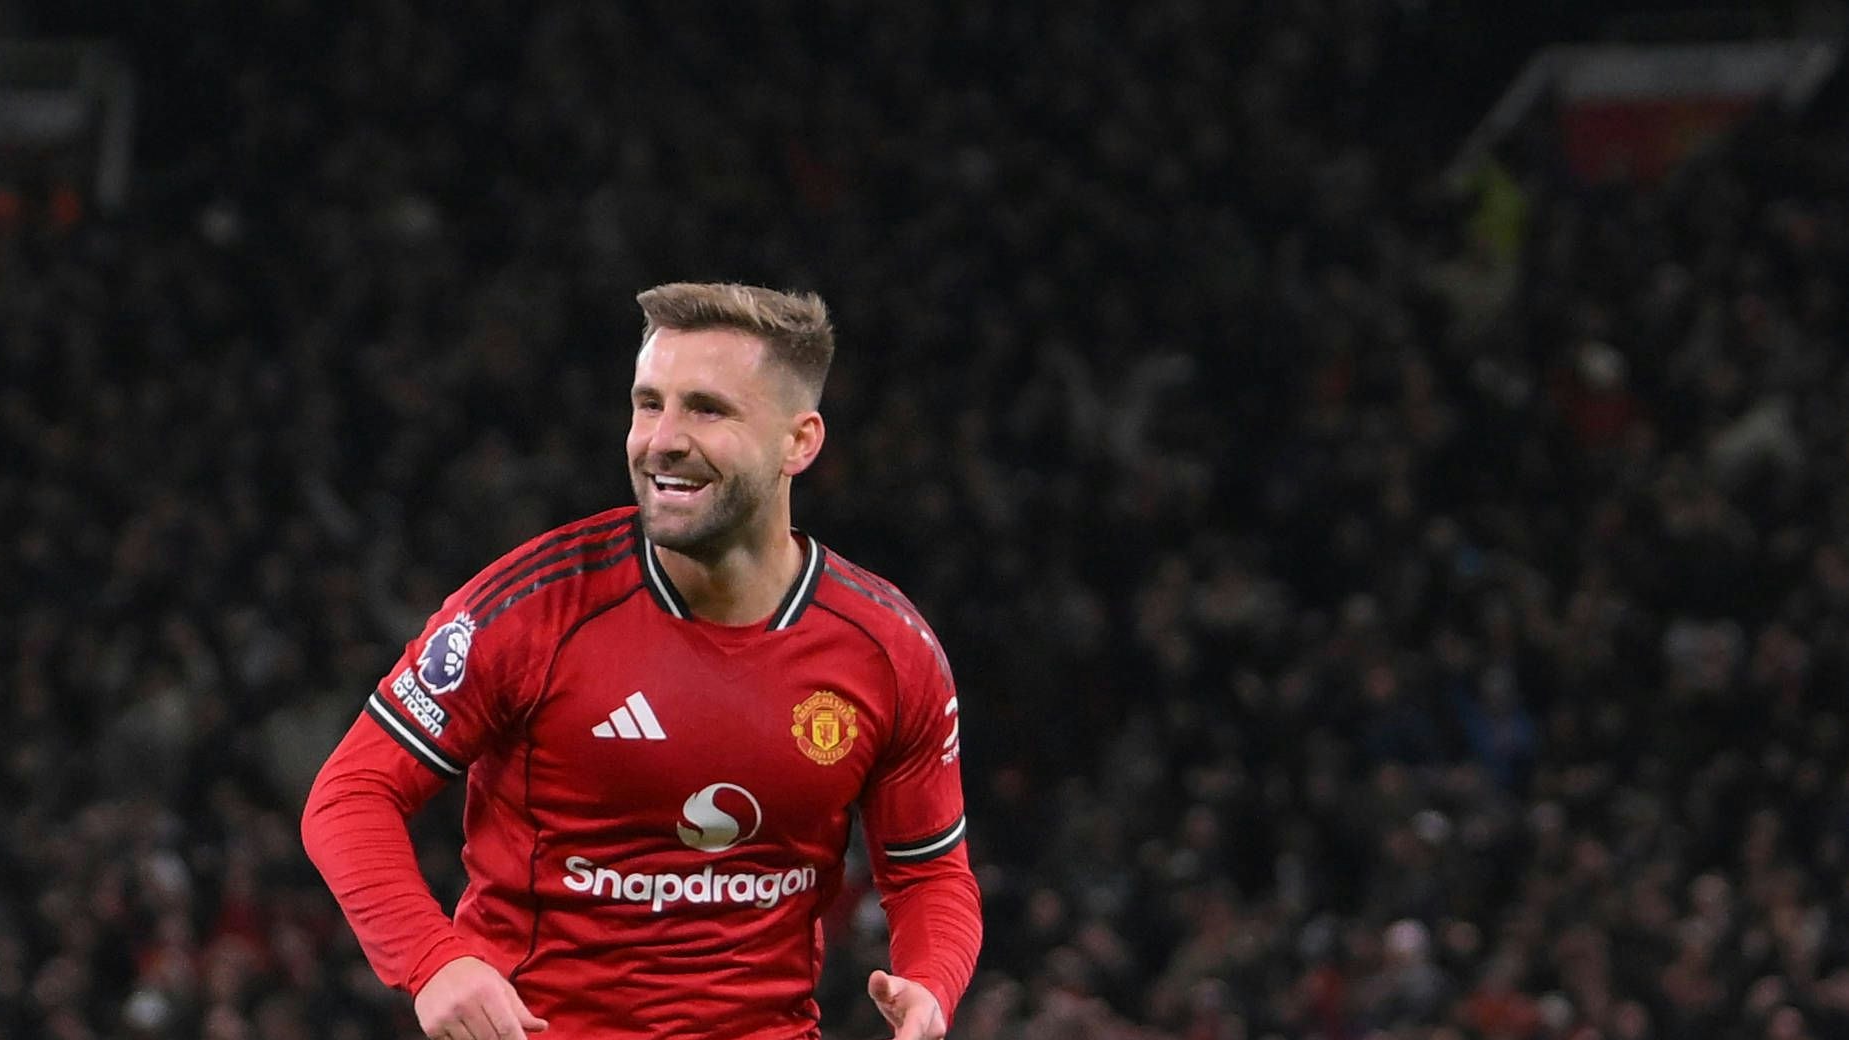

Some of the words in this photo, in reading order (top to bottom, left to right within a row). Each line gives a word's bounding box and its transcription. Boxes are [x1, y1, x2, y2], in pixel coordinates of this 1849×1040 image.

[402, 694, 444, 738] racism
[411, 684, 446, 723] room
[563, 856, 817, 912] Snapdragon
